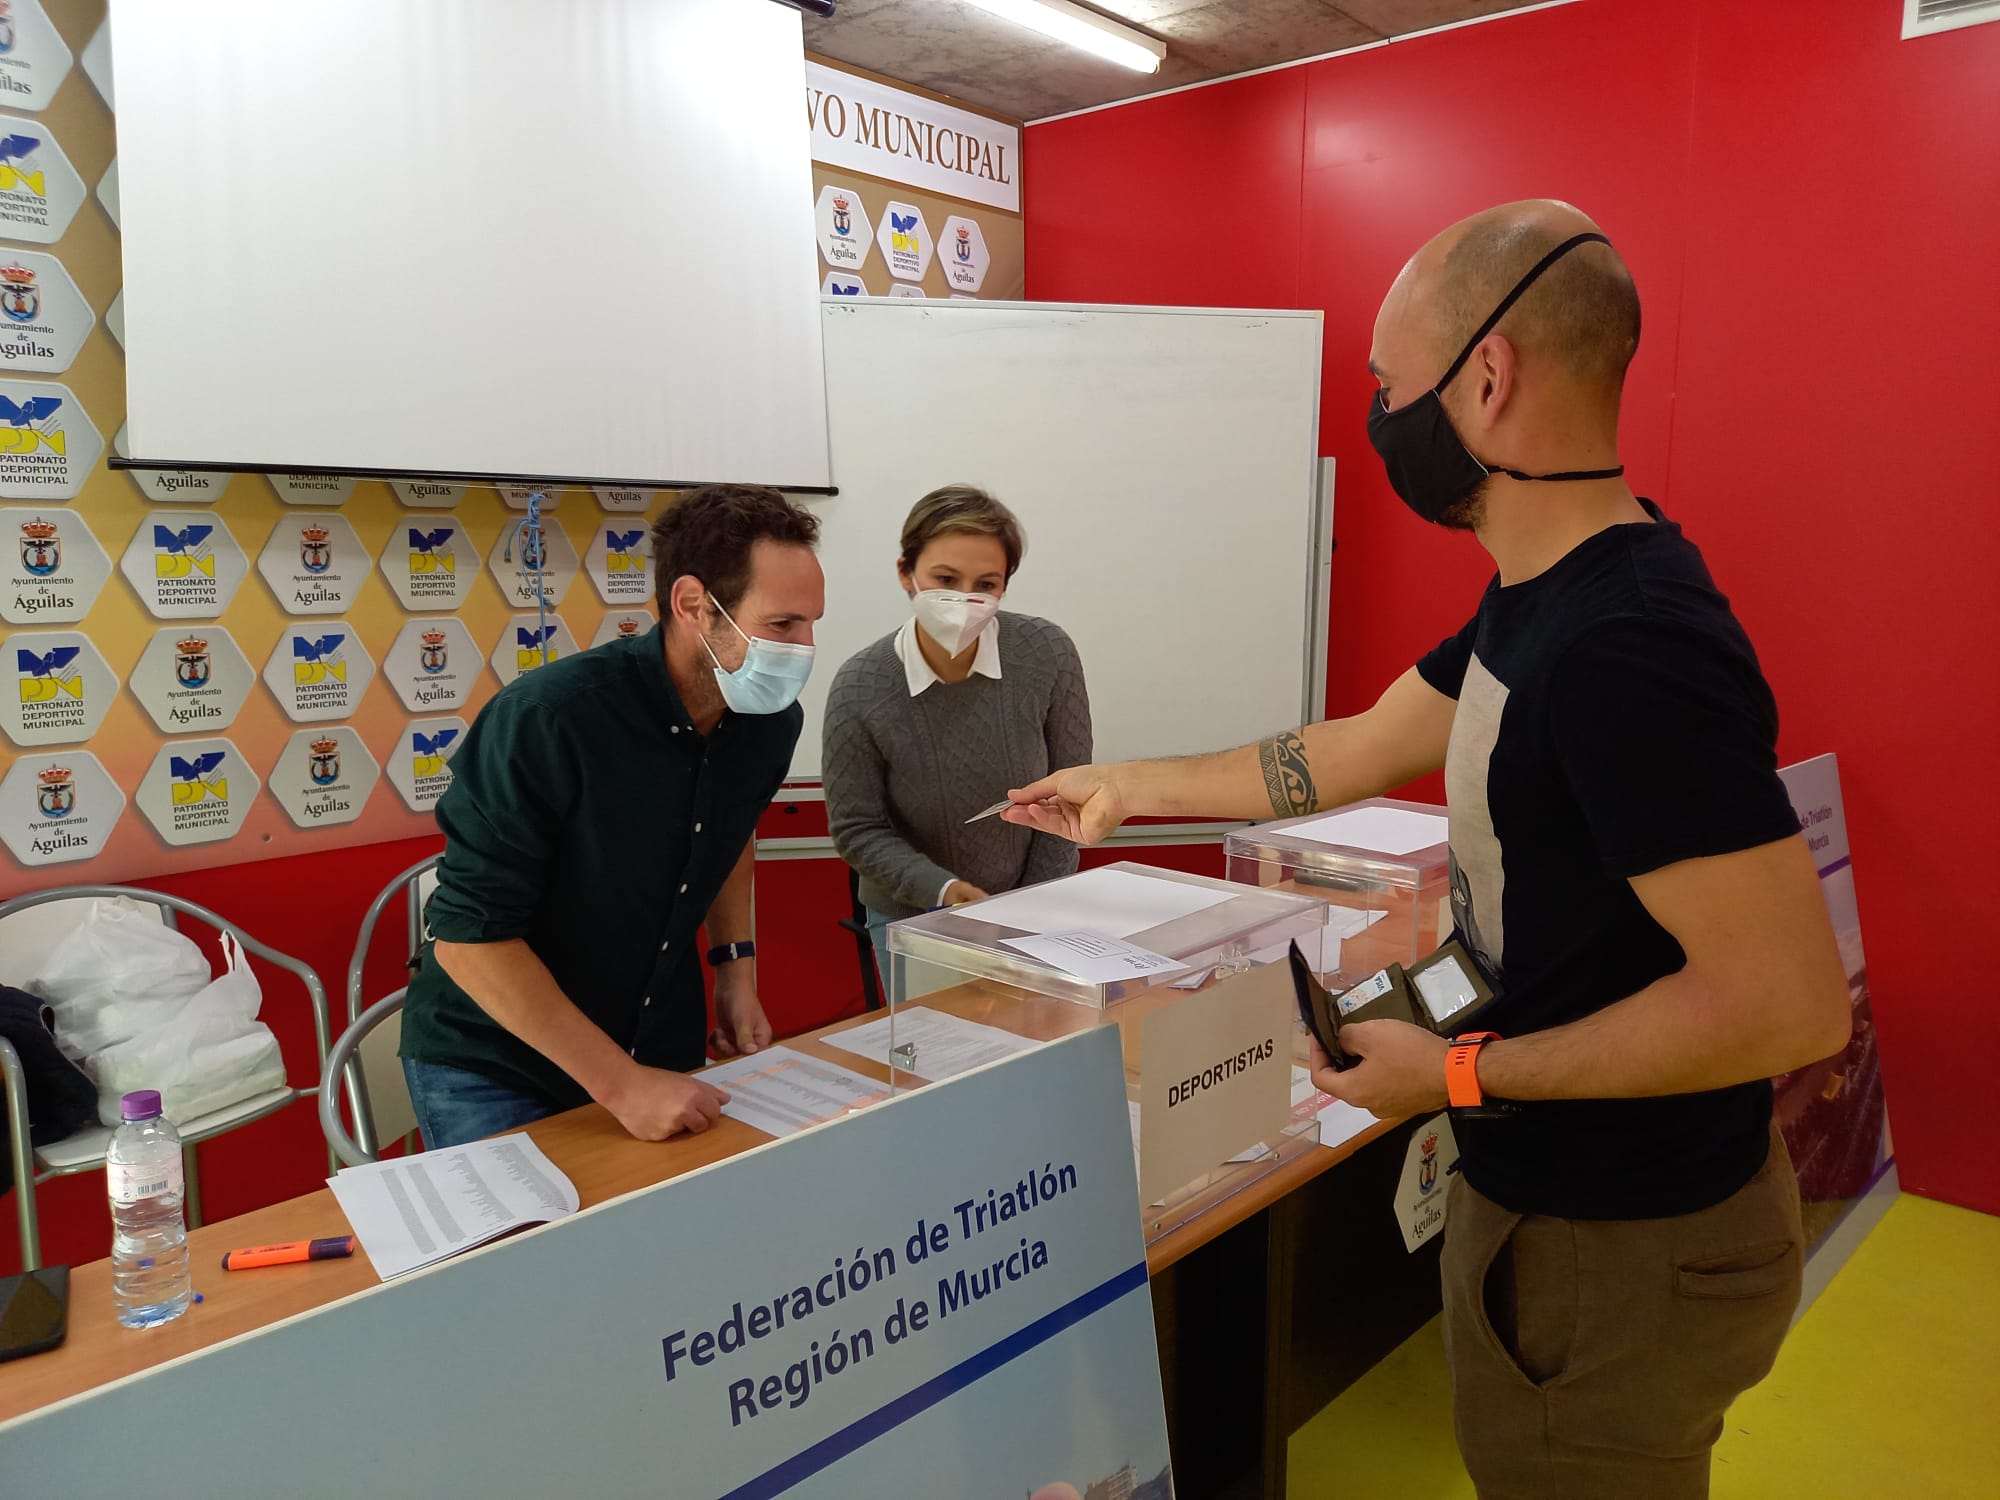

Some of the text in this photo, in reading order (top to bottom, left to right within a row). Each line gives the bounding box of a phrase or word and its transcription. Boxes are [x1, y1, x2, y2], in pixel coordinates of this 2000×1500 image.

[854, 102, 1011, 185] MUNICIPAL
[0, 322, 54, 334] untamiento
[17, 332, 30, 341] de
[0, 454, 67, 465] PATRONATO
[1, 465, 68, 475] DEPORTIVO
[1, 475, 69, 485] MUNICIPAL
[156, 473, 209, 491] Águilas
[290, 482, 340, 490] MUNICIPAL
[11, 576, 74, 587] Ayuntamiento
[157, 578, 216, 587] PATRONATO
[292, 574, 341, 583] Ayuntamiento
[38, 586, 49, 595] de
[158, 587, 216, 596] DEPORTIVO
[313, 582, 322, 590] de
[158, 596, 217, 605] MUNICIPAL
[294, 589, 341, 606] Águilas
[14, 594, 74, 613] Águilas
[167, 688, 222, 699] Ayuntamiento
[295, 683, 348, 693] PATRONATO
[296, 691, 348, 702] DEPORTIVO
[414, 687, 456, 704] Águilas
[21, 700, 84, 711] PATRONATO
[296, 700, 348, 710] MUNICIPAL
[22, 709, 84, 721] DEPORTIVO
[169, 704, 222, 723] Águilas
[23, 718, 85, 730] MUNICIPAL
[322, 793, 331, 801] de
[173, 801, 229, 813] PATRONATO
[303, 799, 350, 818] Águilas
[174, 809, 229, 822] DEPORTIVO
[28, 816, 88, 830] Ayuntamiento
[175, 818, 230, 830] MUNICIPAL
[54, 827, 65, 837] de
[31, 834, 88, 854] Águilas
[1168, 1038, 1273, 1108] DEPORTISTAS
[1412, 1208, 1441, 1239] Águilas
[661, 1162, 1078, 1382] Federación de Triatlón
[728, 1237, 1048, 1427] Región de Murcia
